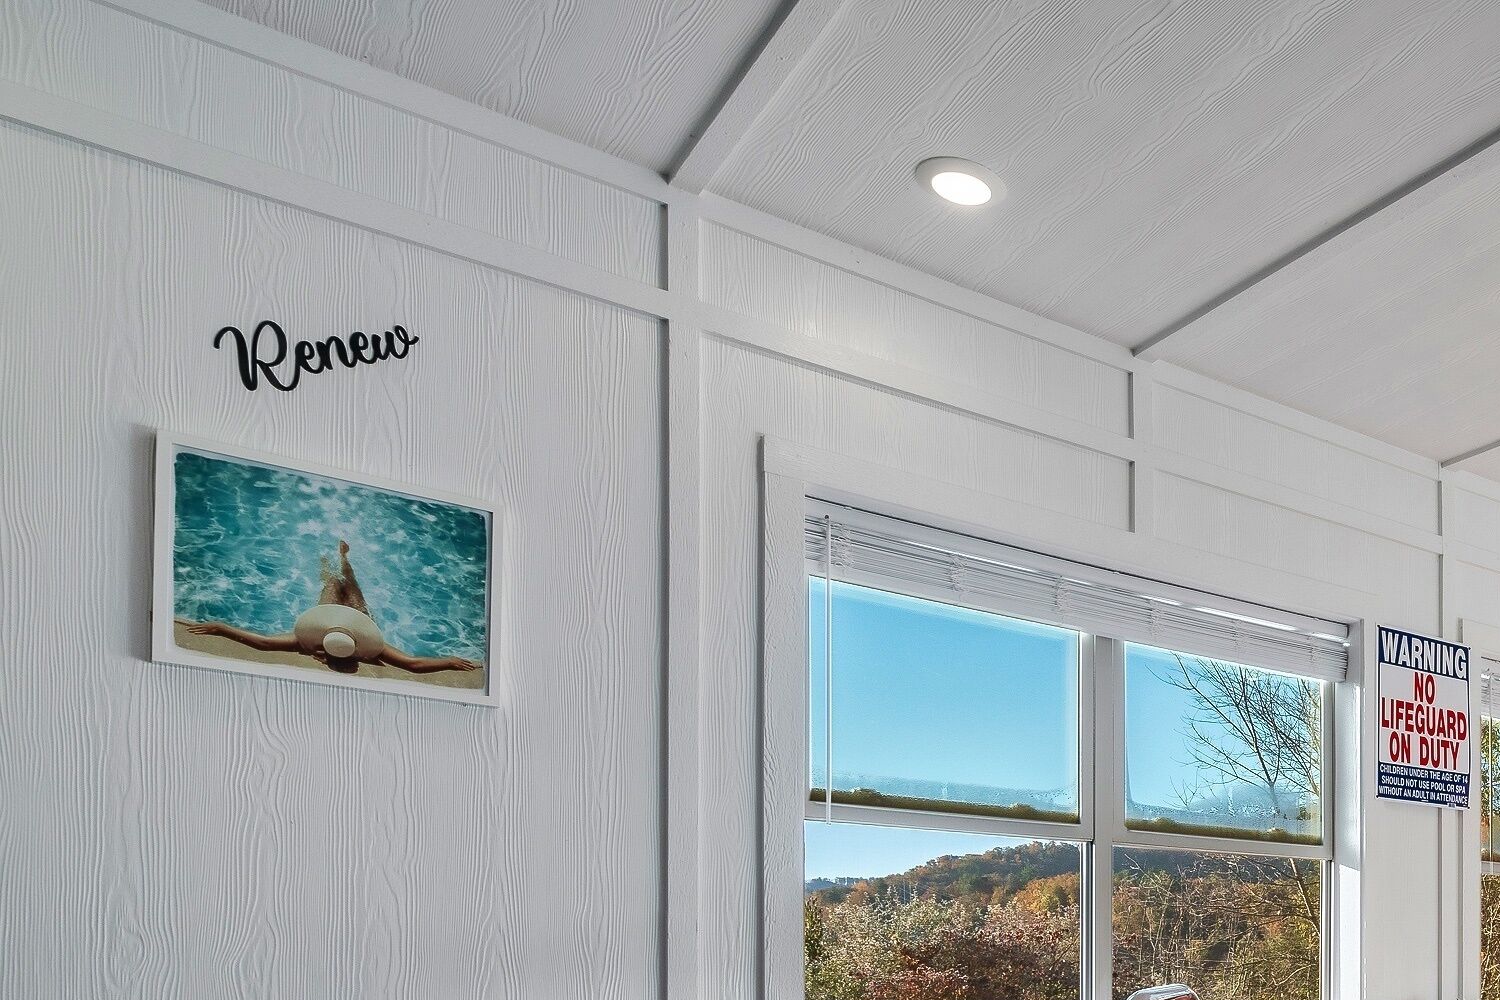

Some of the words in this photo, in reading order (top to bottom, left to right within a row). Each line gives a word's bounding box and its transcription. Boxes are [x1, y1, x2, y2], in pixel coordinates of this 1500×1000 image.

[214, 320, 419, 391] Renew
[1381, 630, 1467, 679] WARNING
[1414, 672, 1435, 704] NO
[1381, 697, 1467, 741] LIFEGUARD
[1389, 731, 1410, 763] ON
[1420, 736, 1459, 770] DUTY
[1380, 764, 1408, 776] CHILDREN
[1409, 768, 1428, 778] UNDER
[1429, 770, 1440, 780] THE
[1441, 772, 1453, 782] AGE
[1454, 774, 1462, 782] OF
[1462, 775, 1468, 783] 14
[1381, 775, 1404, 786] SHOULD
[1405, 778, 1417, 788] NOT
[1418, 780, 1430, 790] USE
[1430, 781, 1446, 792] POOL
[1446, 784, 1455, 792] OR
[1455, 785, 1466, 794] SPA
[1379, 785, 1403, 797] WITHOUT
[1403, 788, 1412, 797] AN
[1412, 790, 1429, 800] ADULT
[1430, 791, 1436, 800] IN
[1436, 792, 1468, 804] ATTENDANCE
